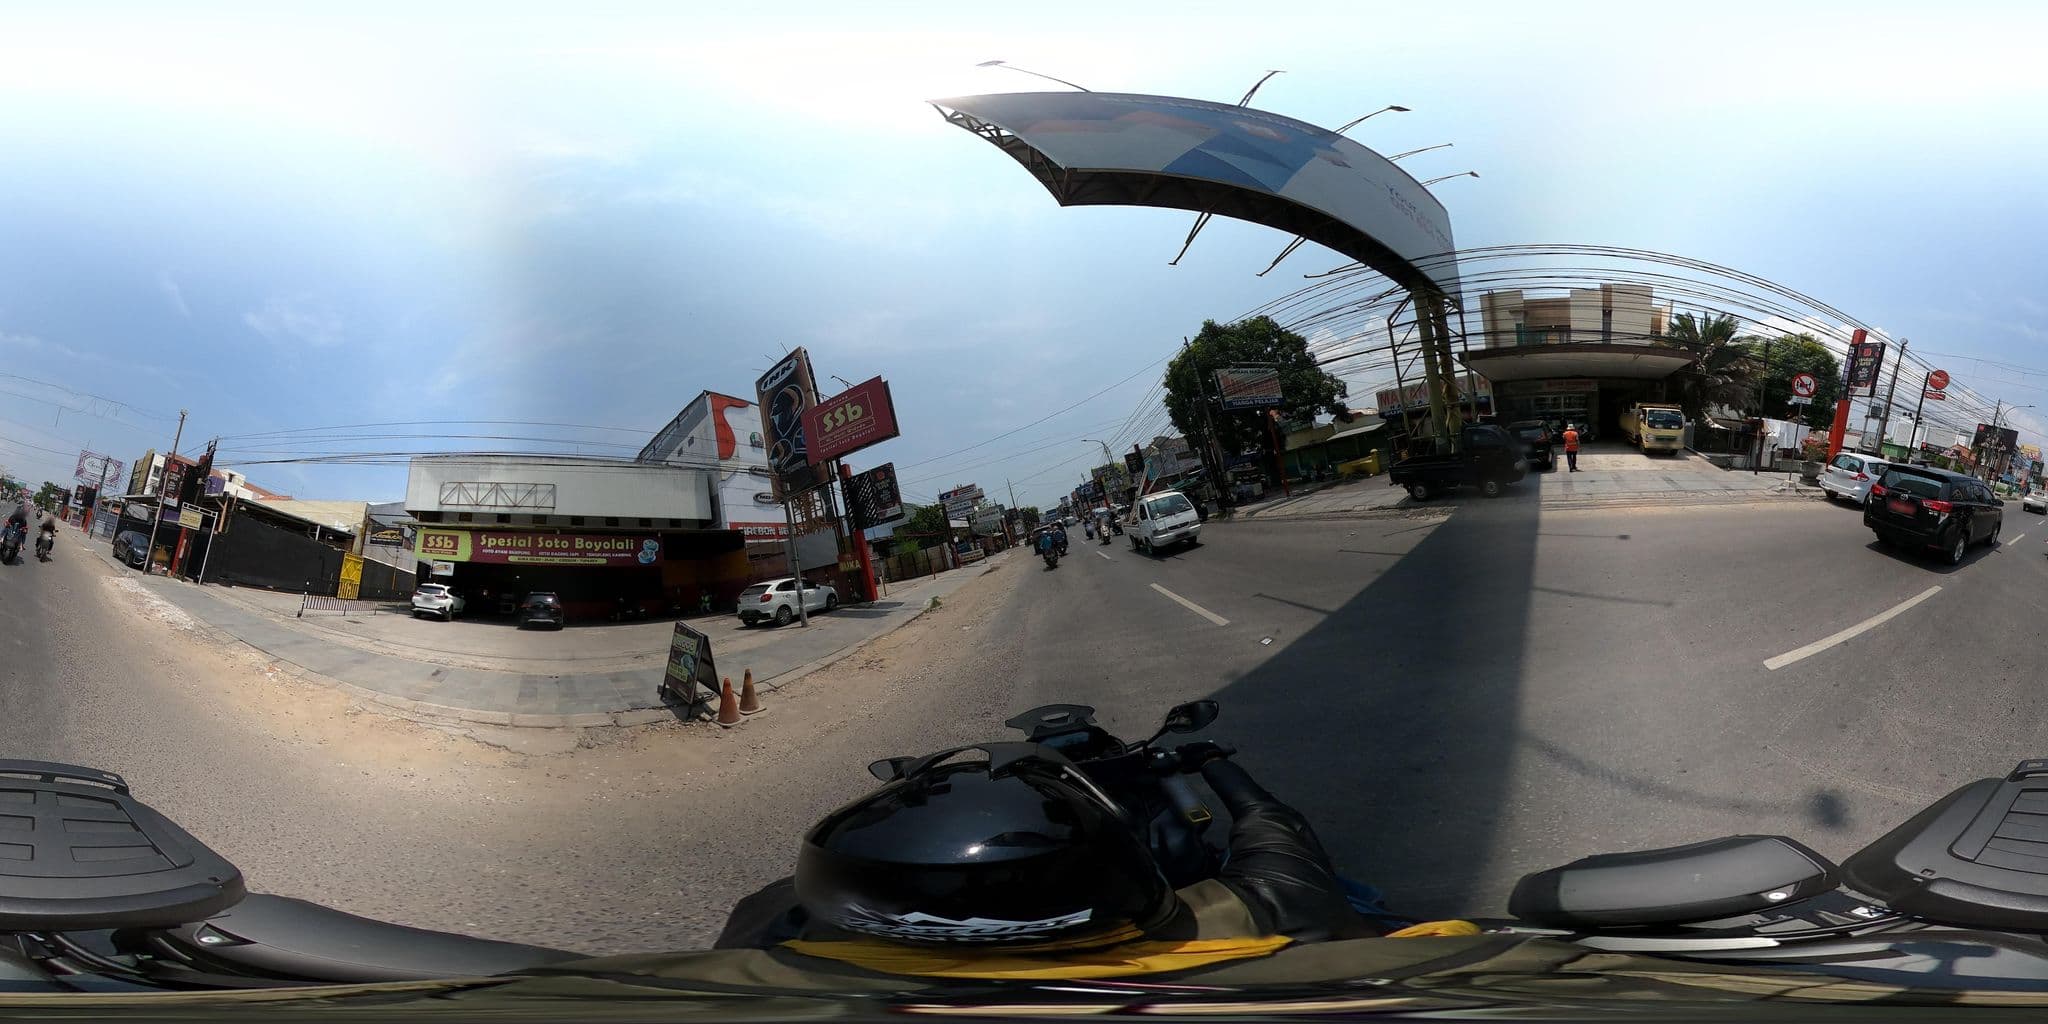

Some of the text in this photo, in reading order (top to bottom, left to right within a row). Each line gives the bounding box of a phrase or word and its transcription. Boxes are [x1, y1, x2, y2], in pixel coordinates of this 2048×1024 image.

[763, 361, 793, 390] INK
[426, 535, 455, 549] SSb
[480, 534, 634, 552] Spesial Soto Boyolali
